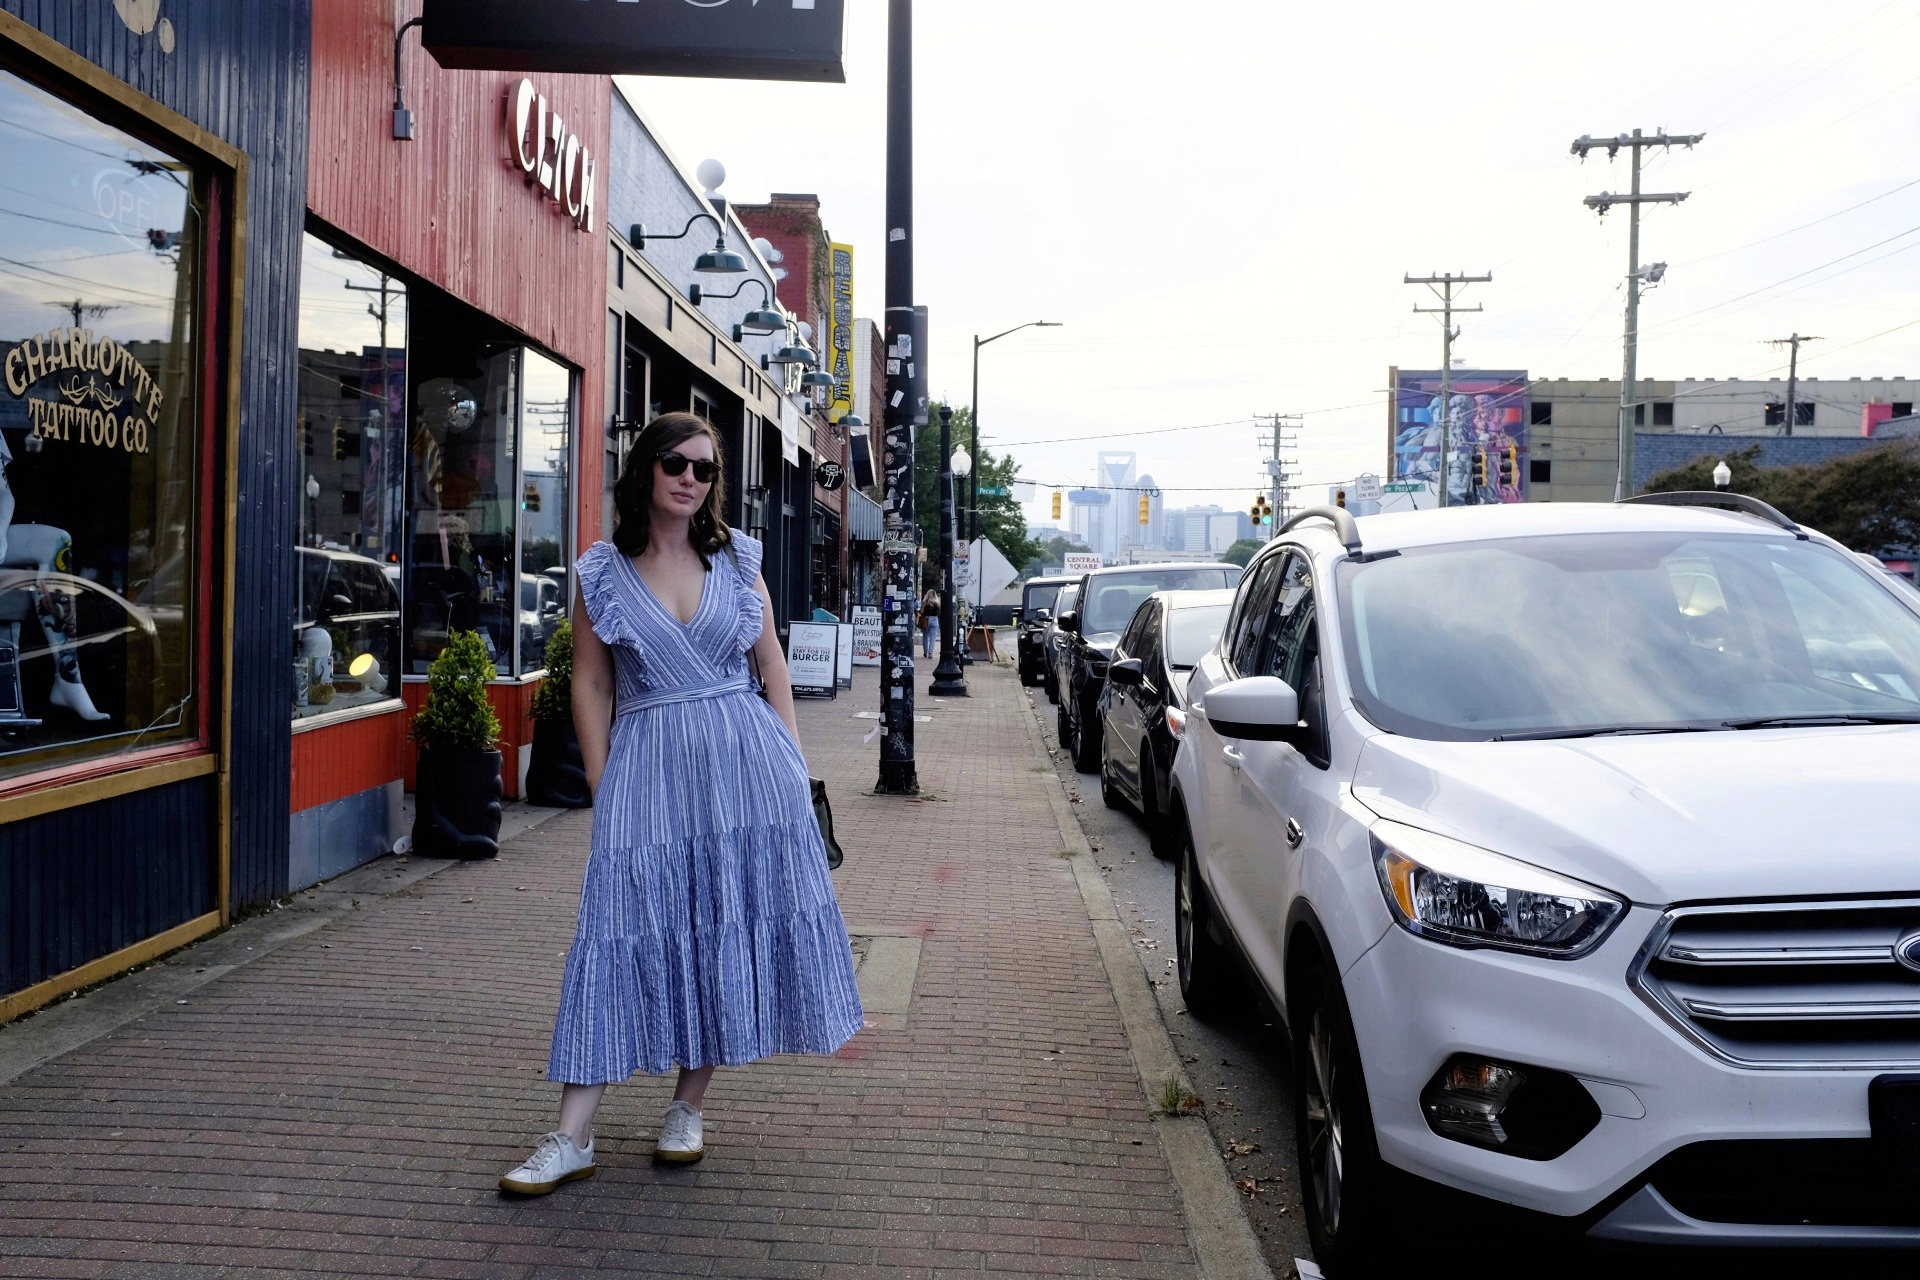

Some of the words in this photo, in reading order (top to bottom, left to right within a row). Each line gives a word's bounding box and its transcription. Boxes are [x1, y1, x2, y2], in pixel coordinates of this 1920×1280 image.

[5, 326, 164, 426] CHARLOTTE
[28, 397, 118, 449] TATTOO
[122, 415, 149, 455] CO.
[979, 487, 996, 495] Pecan
[854, 616, 881, 627] BEAUT
[857, 639, 882, 648] BRAIDIN
[792, 653, 830, 662] BURGER
